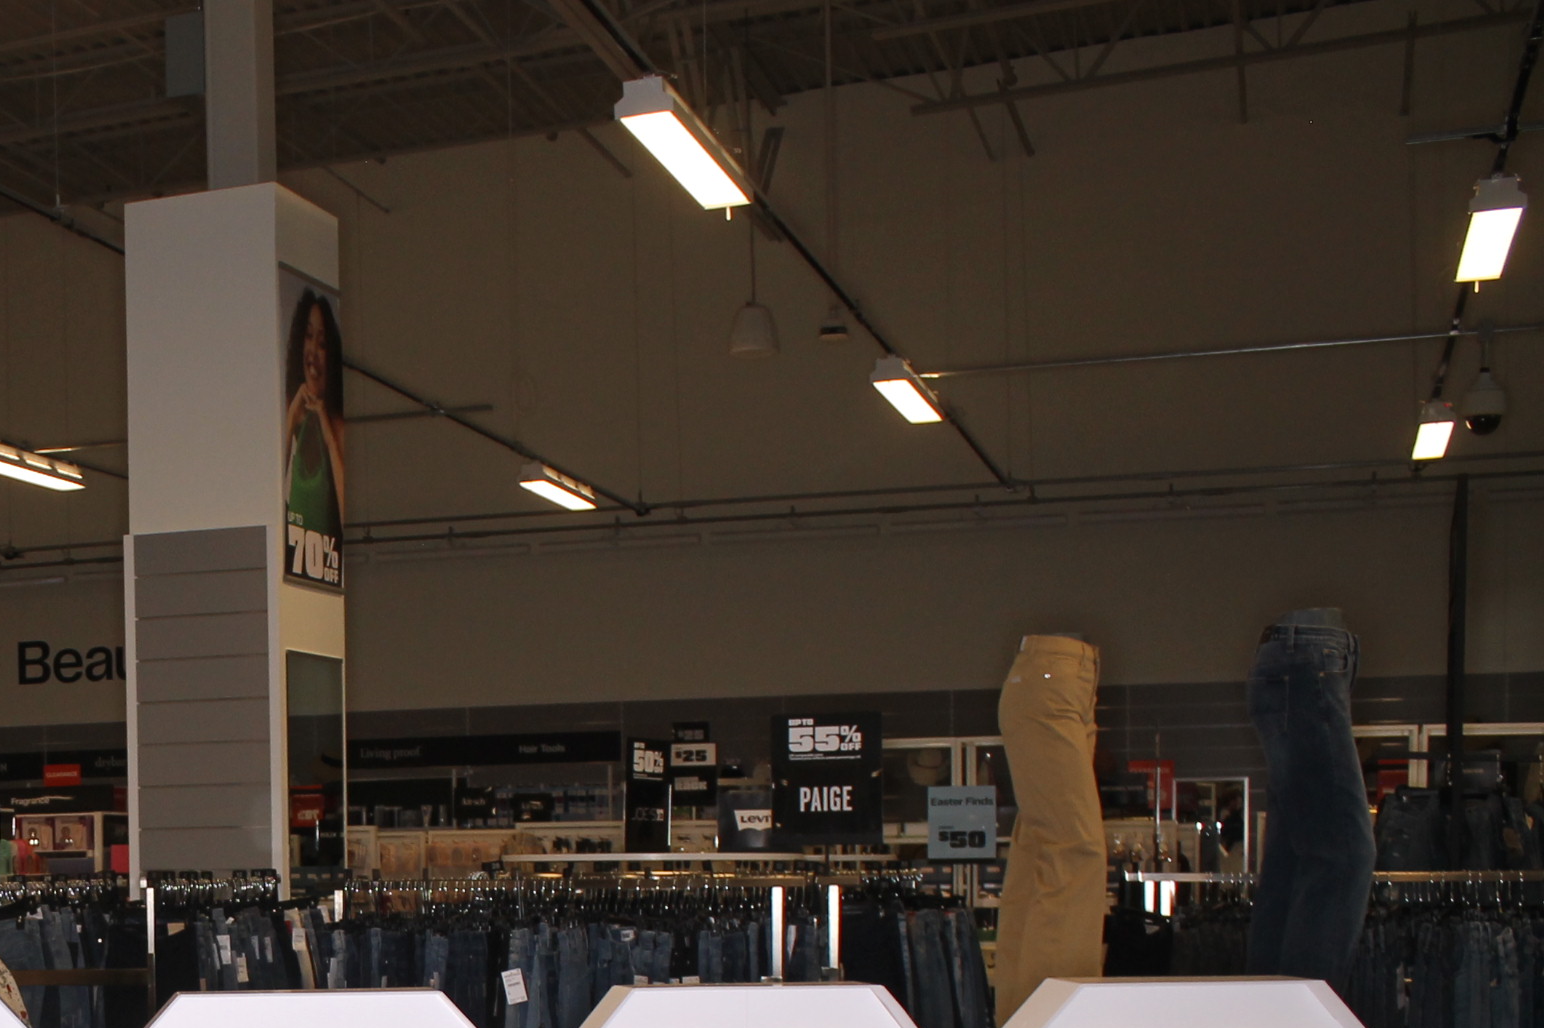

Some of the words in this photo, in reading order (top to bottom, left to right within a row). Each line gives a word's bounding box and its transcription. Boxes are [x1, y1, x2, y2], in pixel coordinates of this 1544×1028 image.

[288, 524, 339, 579] 70%
[323, 567, 338, 584] OFF
[788, 725, 862, 753] 55%
[840, 743, 862, 751] OFF
[799, 786, 853, 812] PAIGE
[938, 831, 986, 848] $50
